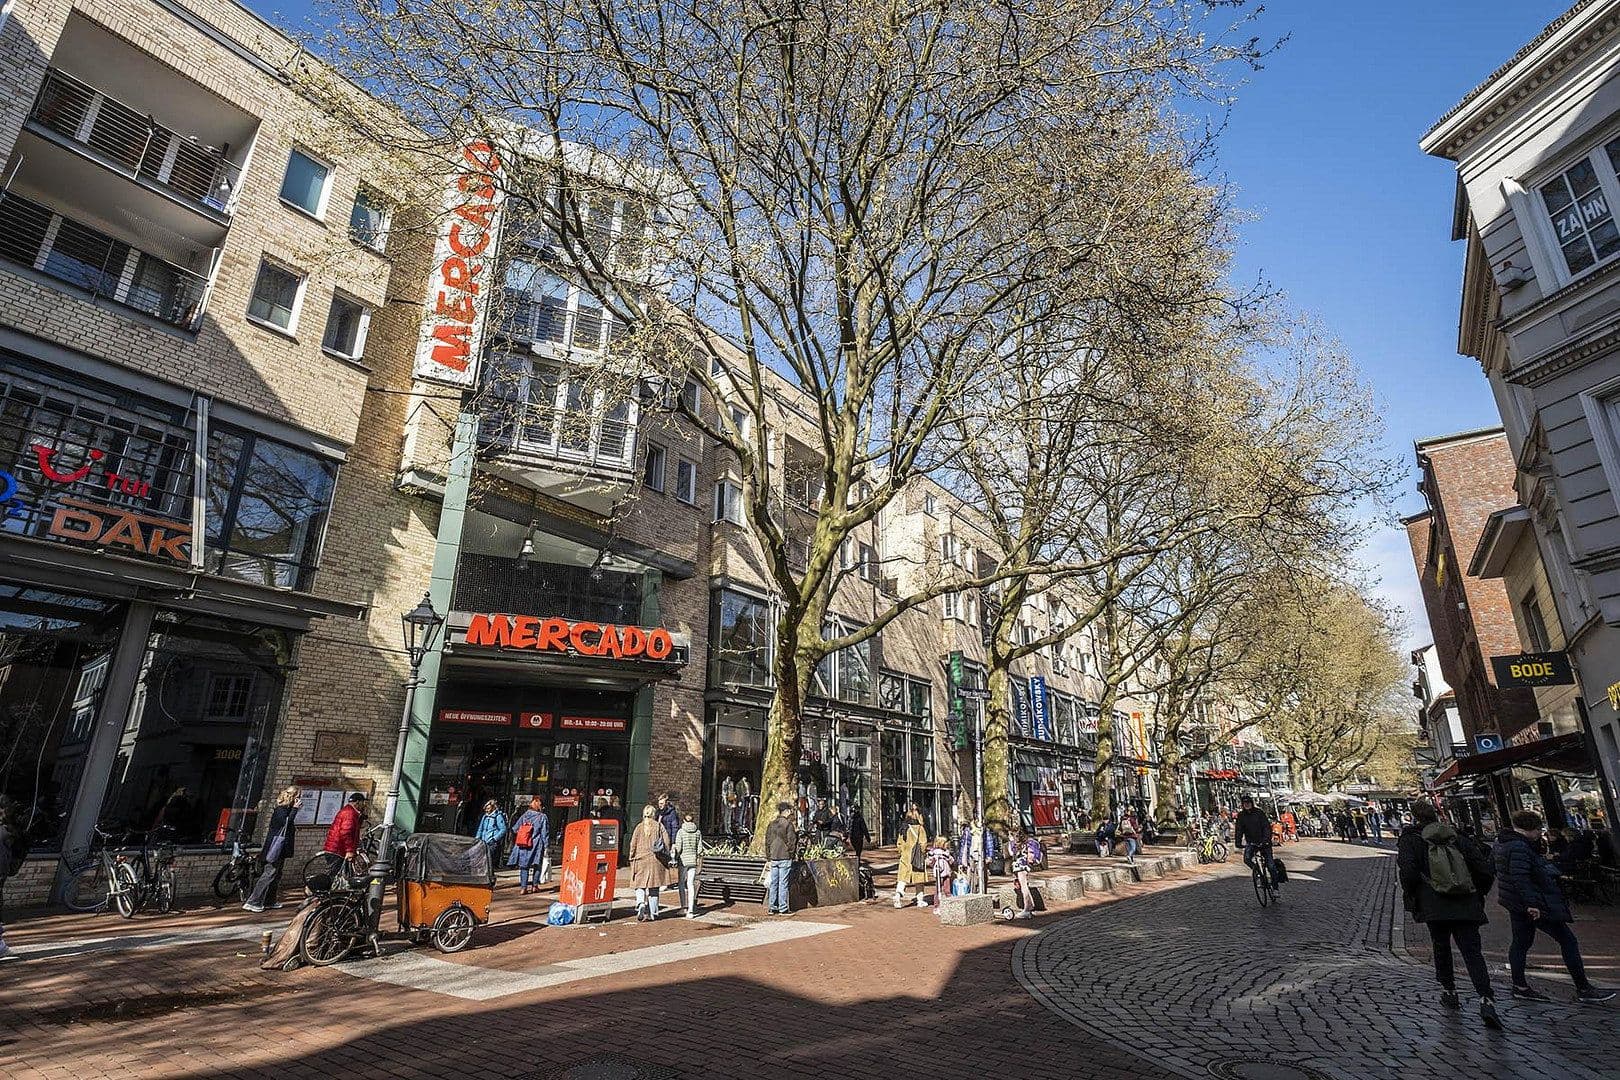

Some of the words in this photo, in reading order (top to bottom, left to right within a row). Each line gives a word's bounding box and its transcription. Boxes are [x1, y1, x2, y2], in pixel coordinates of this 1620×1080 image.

[1557, 195, 1608, 238] ZAHN
[430, 139, 501, 373] MERCADO
[104, 471, 150, 498] TUI
[50, 498, 192, 562] DAK
[466, 613, 673, 660] MERCADO
[1510, 662, 1555, 678] BODE
